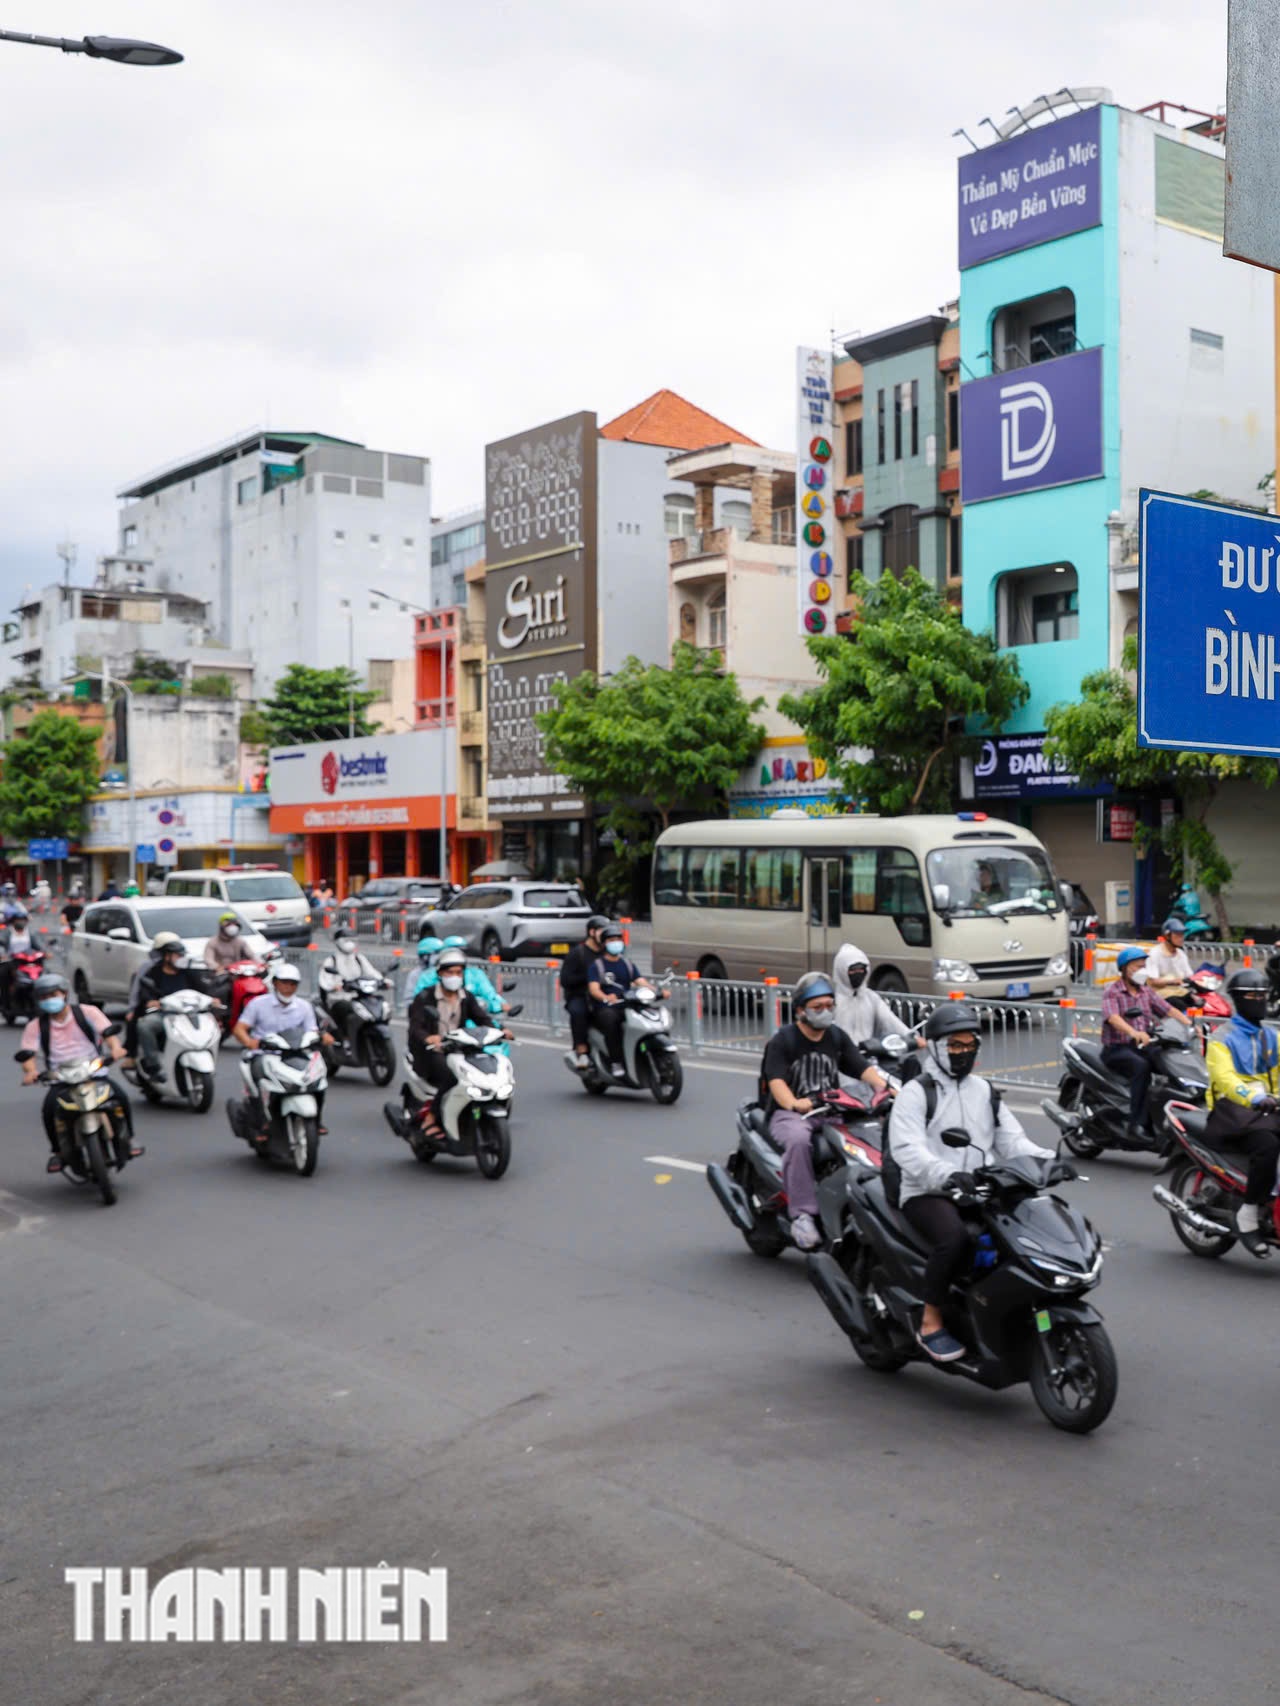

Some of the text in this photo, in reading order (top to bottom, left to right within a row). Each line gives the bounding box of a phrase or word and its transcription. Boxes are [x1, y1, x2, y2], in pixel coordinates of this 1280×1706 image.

[960, 142, 1098, 206] Thẩm Mỹ Chuẩn Mực
[970, 213, 988, 237] Vẻ
[991, 208, 1019, 231] Đẹp
[1050, 184, 1087, 210] Vững
[498, 573, 566, 649] Suri
